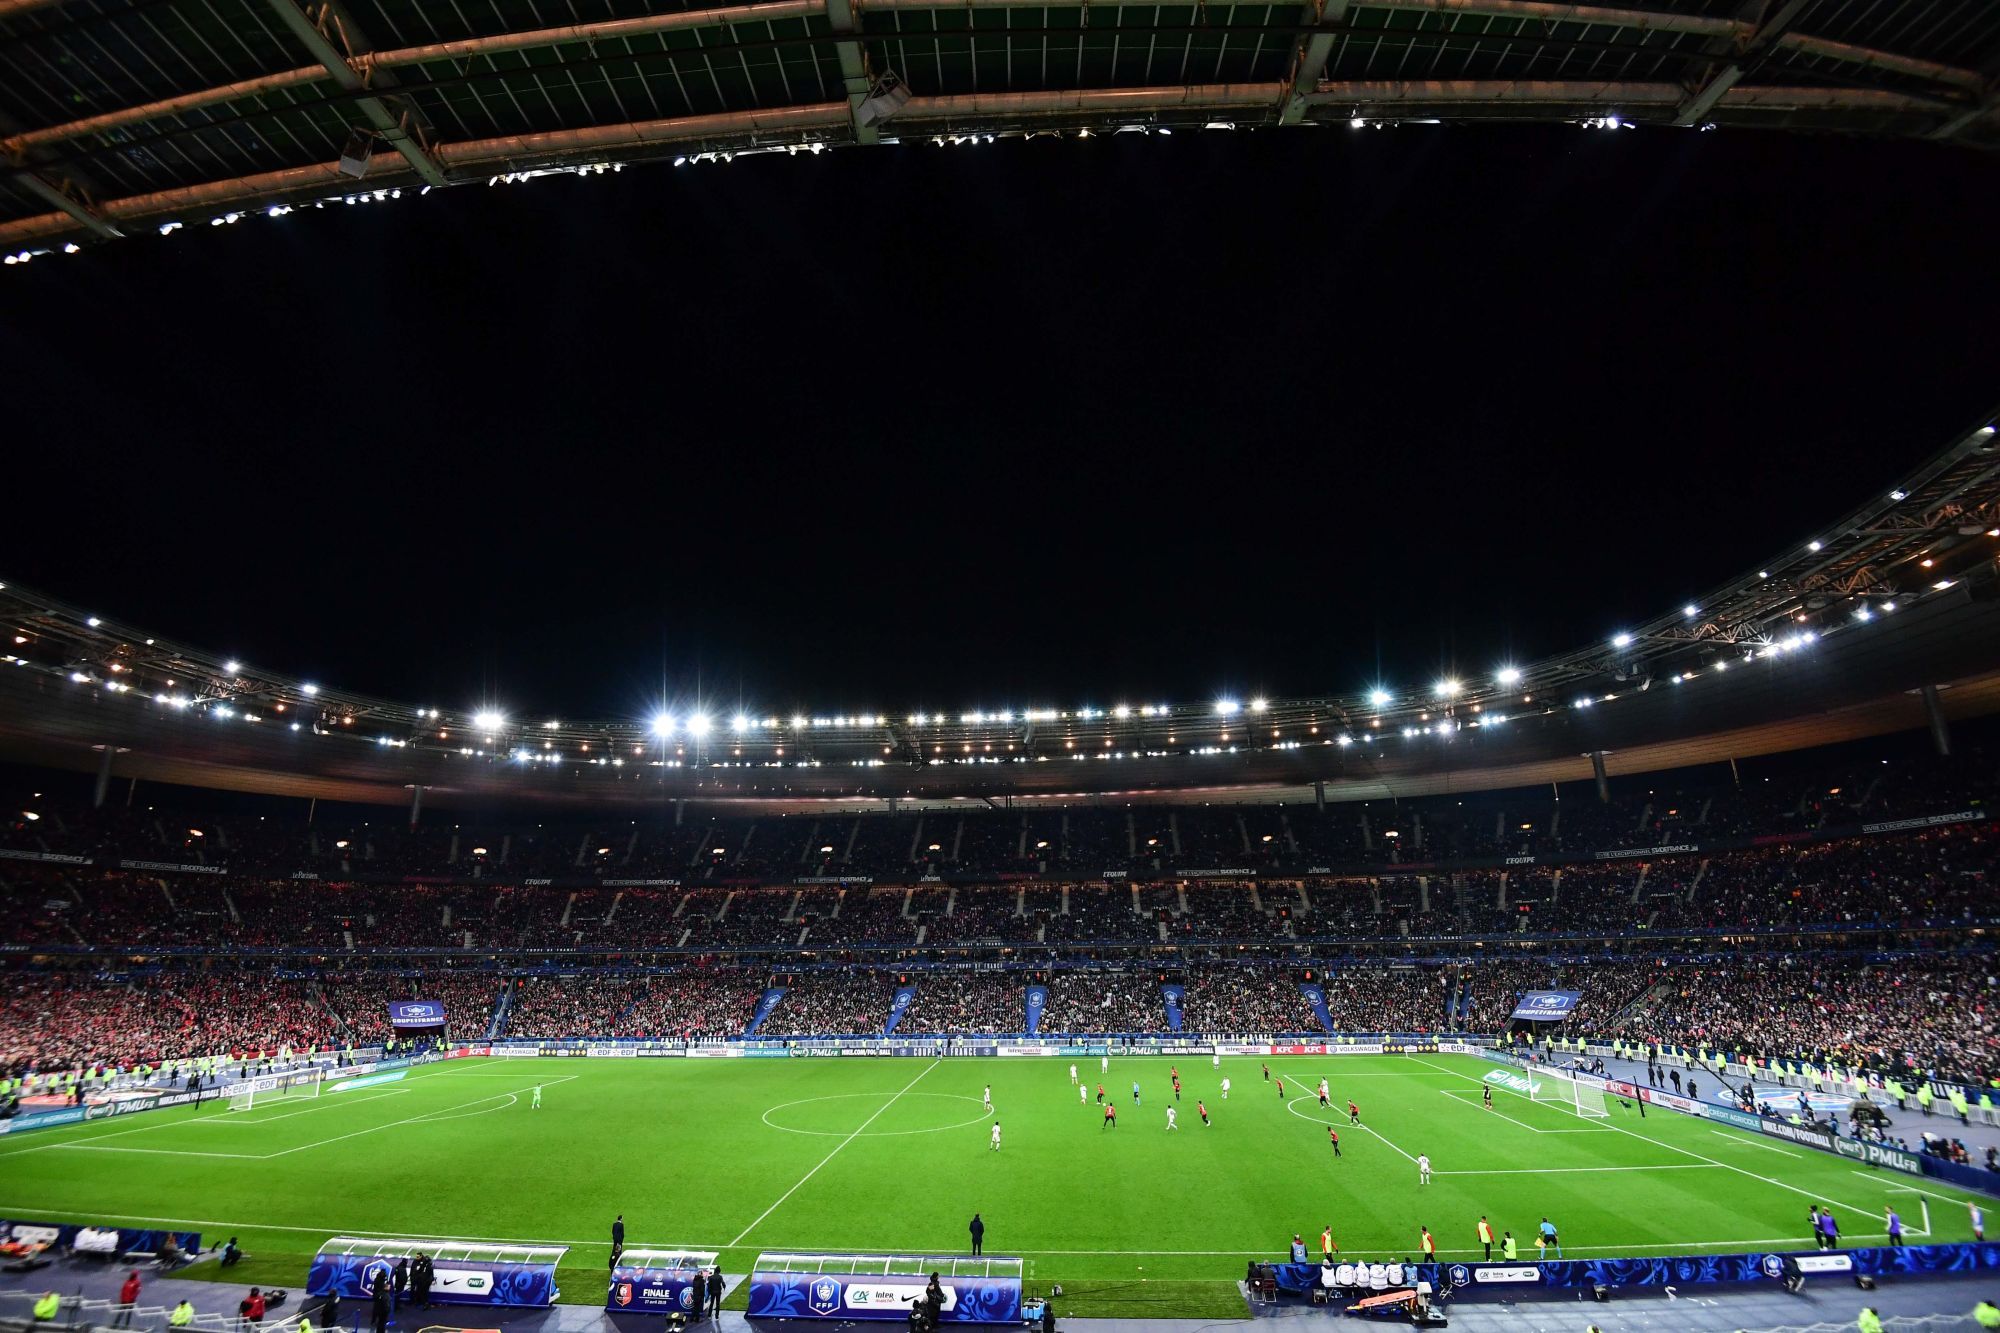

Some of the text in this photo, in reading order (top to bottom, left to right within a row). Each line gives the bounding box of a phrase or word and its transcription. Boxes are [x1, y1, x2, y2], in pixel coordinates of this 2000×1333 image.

[447, 1050, 460, 1058] KFC
[469, 1048, 486, 1056] KFC
[841, 1048, 891, 1056] NIKE.COM/FOOBALL
[913, 1047, 935, 1056] COUPE
[950, 1047, 977, 1056] FRANCE
[1611, 1081, 1623, 1093] KFC
[1632, 1086, 1646, 1099] KC
[1730, 1113, 1761, 1128] AGRICOLE
[1762, 1118, 1832, 1148] NIKE.COM/FOOTBALL
[643, 1288, 670, 1298] FINALE
